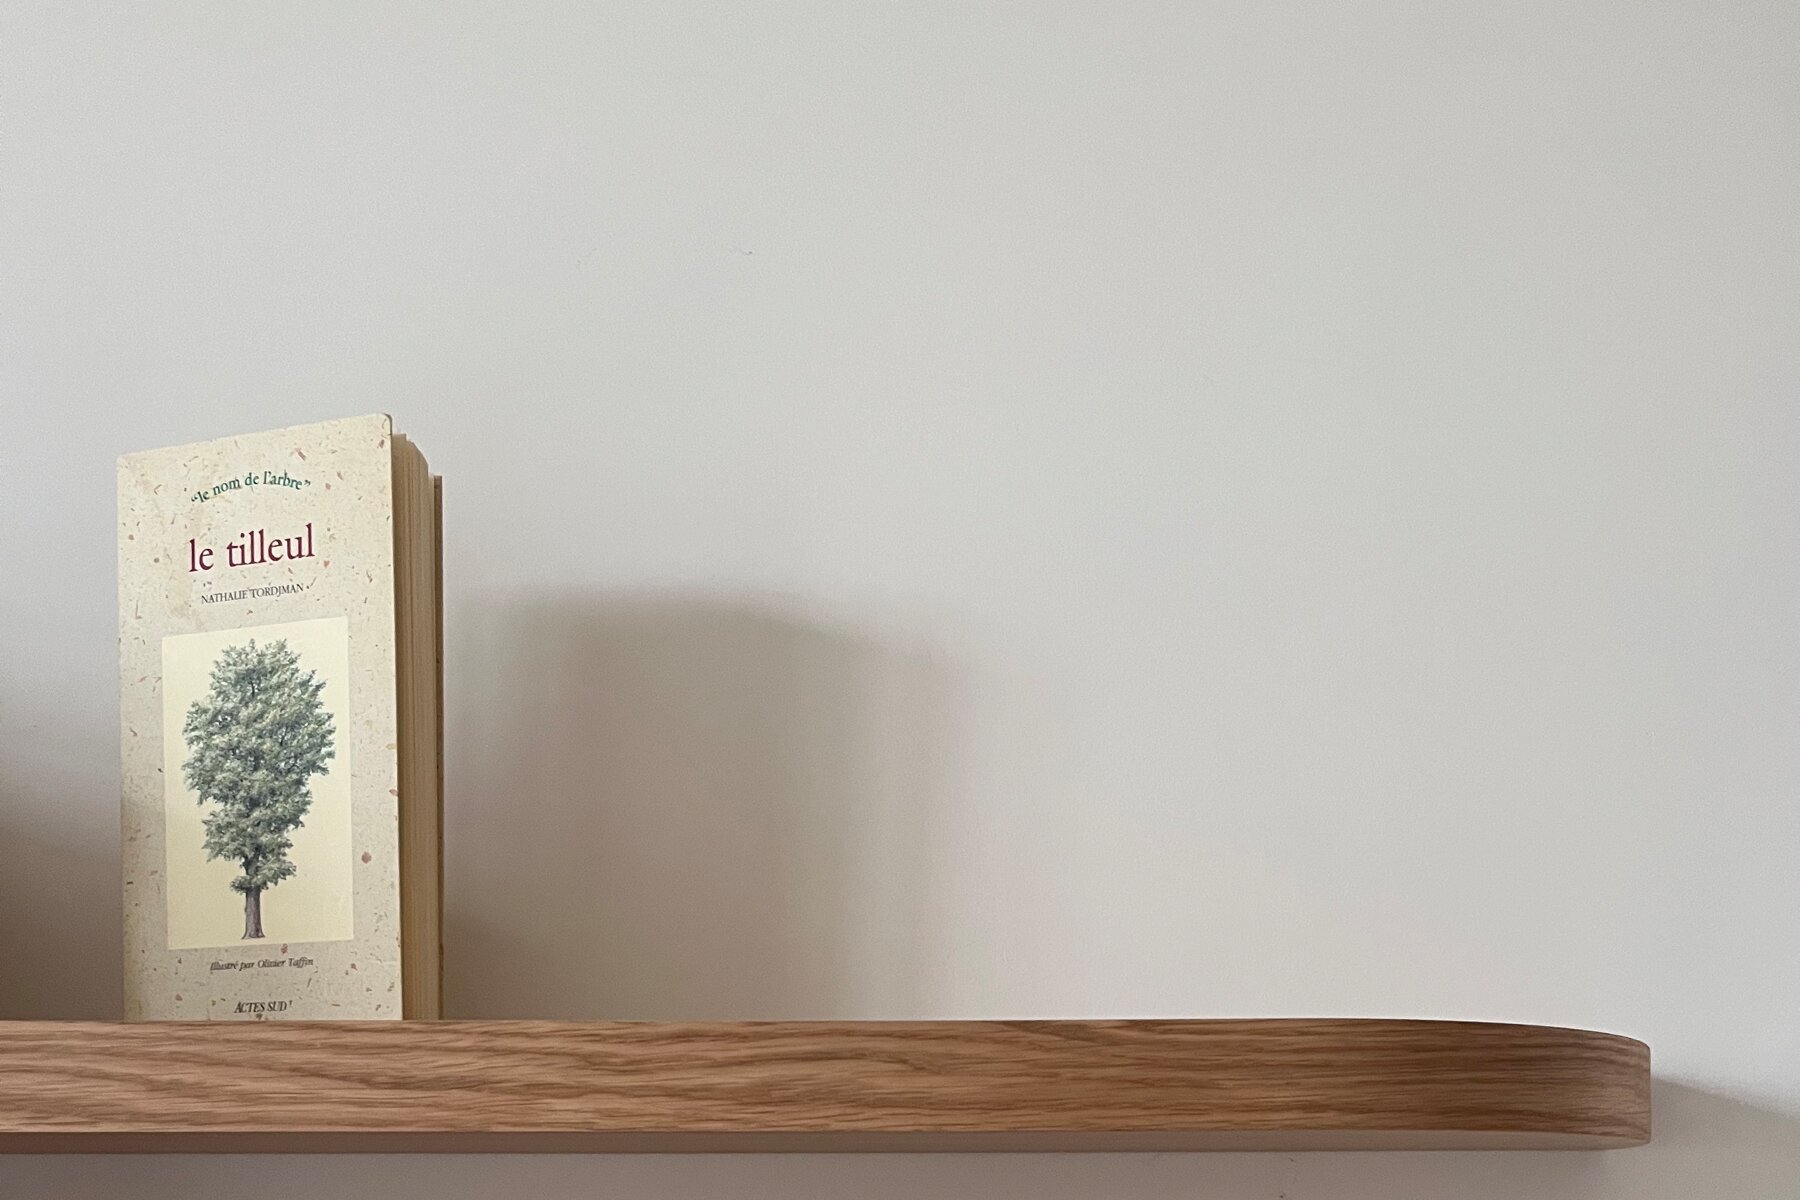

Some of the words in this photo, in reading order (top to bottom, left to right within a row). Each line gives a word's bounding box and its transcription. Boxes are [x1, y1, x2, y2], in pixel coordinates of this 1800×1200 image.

[212, 478, 241, 496] nom
[244, 472, 260, 486] de
[189, 538, 214, 572] le
[226, 522, 316, 568] tilleul
[201, 589, 248, 604] NATHALIE
[249, 583, 304, 599] TORDJMAN
[239, 962, 255, 972] par
[257, 959, 286, 969] Olivier
[288, 957, 314, 969] Taffin
[233, 1001, 266, 1013] ACTES
[267, 1001, 287, 1012] SUD
